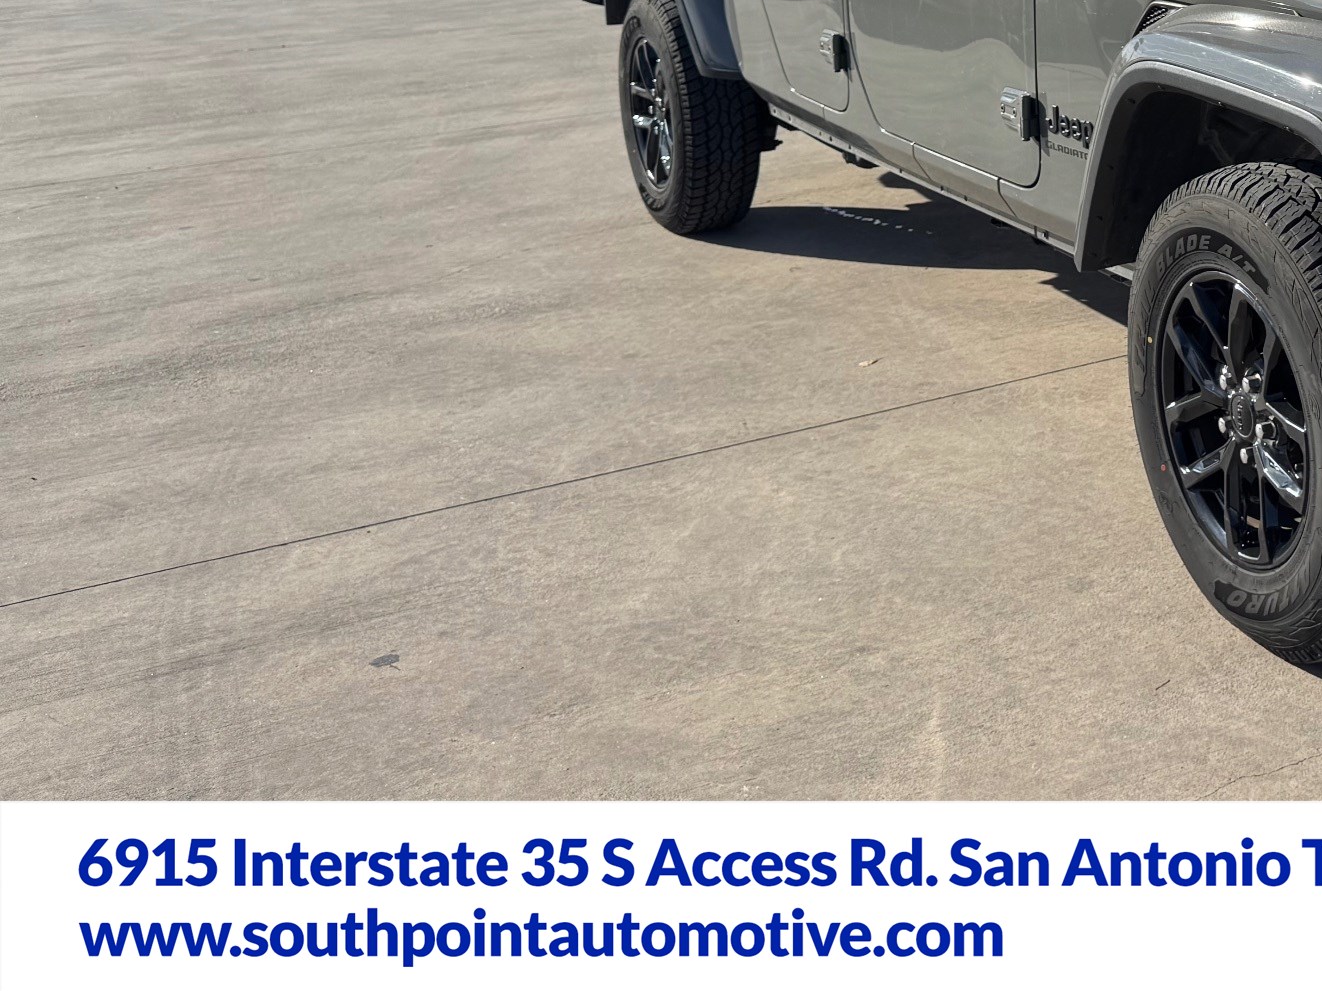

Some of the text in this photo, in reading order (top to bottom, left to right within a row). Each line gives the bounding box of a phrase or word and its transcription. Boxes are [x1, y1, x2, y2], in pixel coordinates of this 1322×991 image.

[1045, 104, 1094, 150] Jeep
[1156, 233, 1256, 276] BLADE A/T
